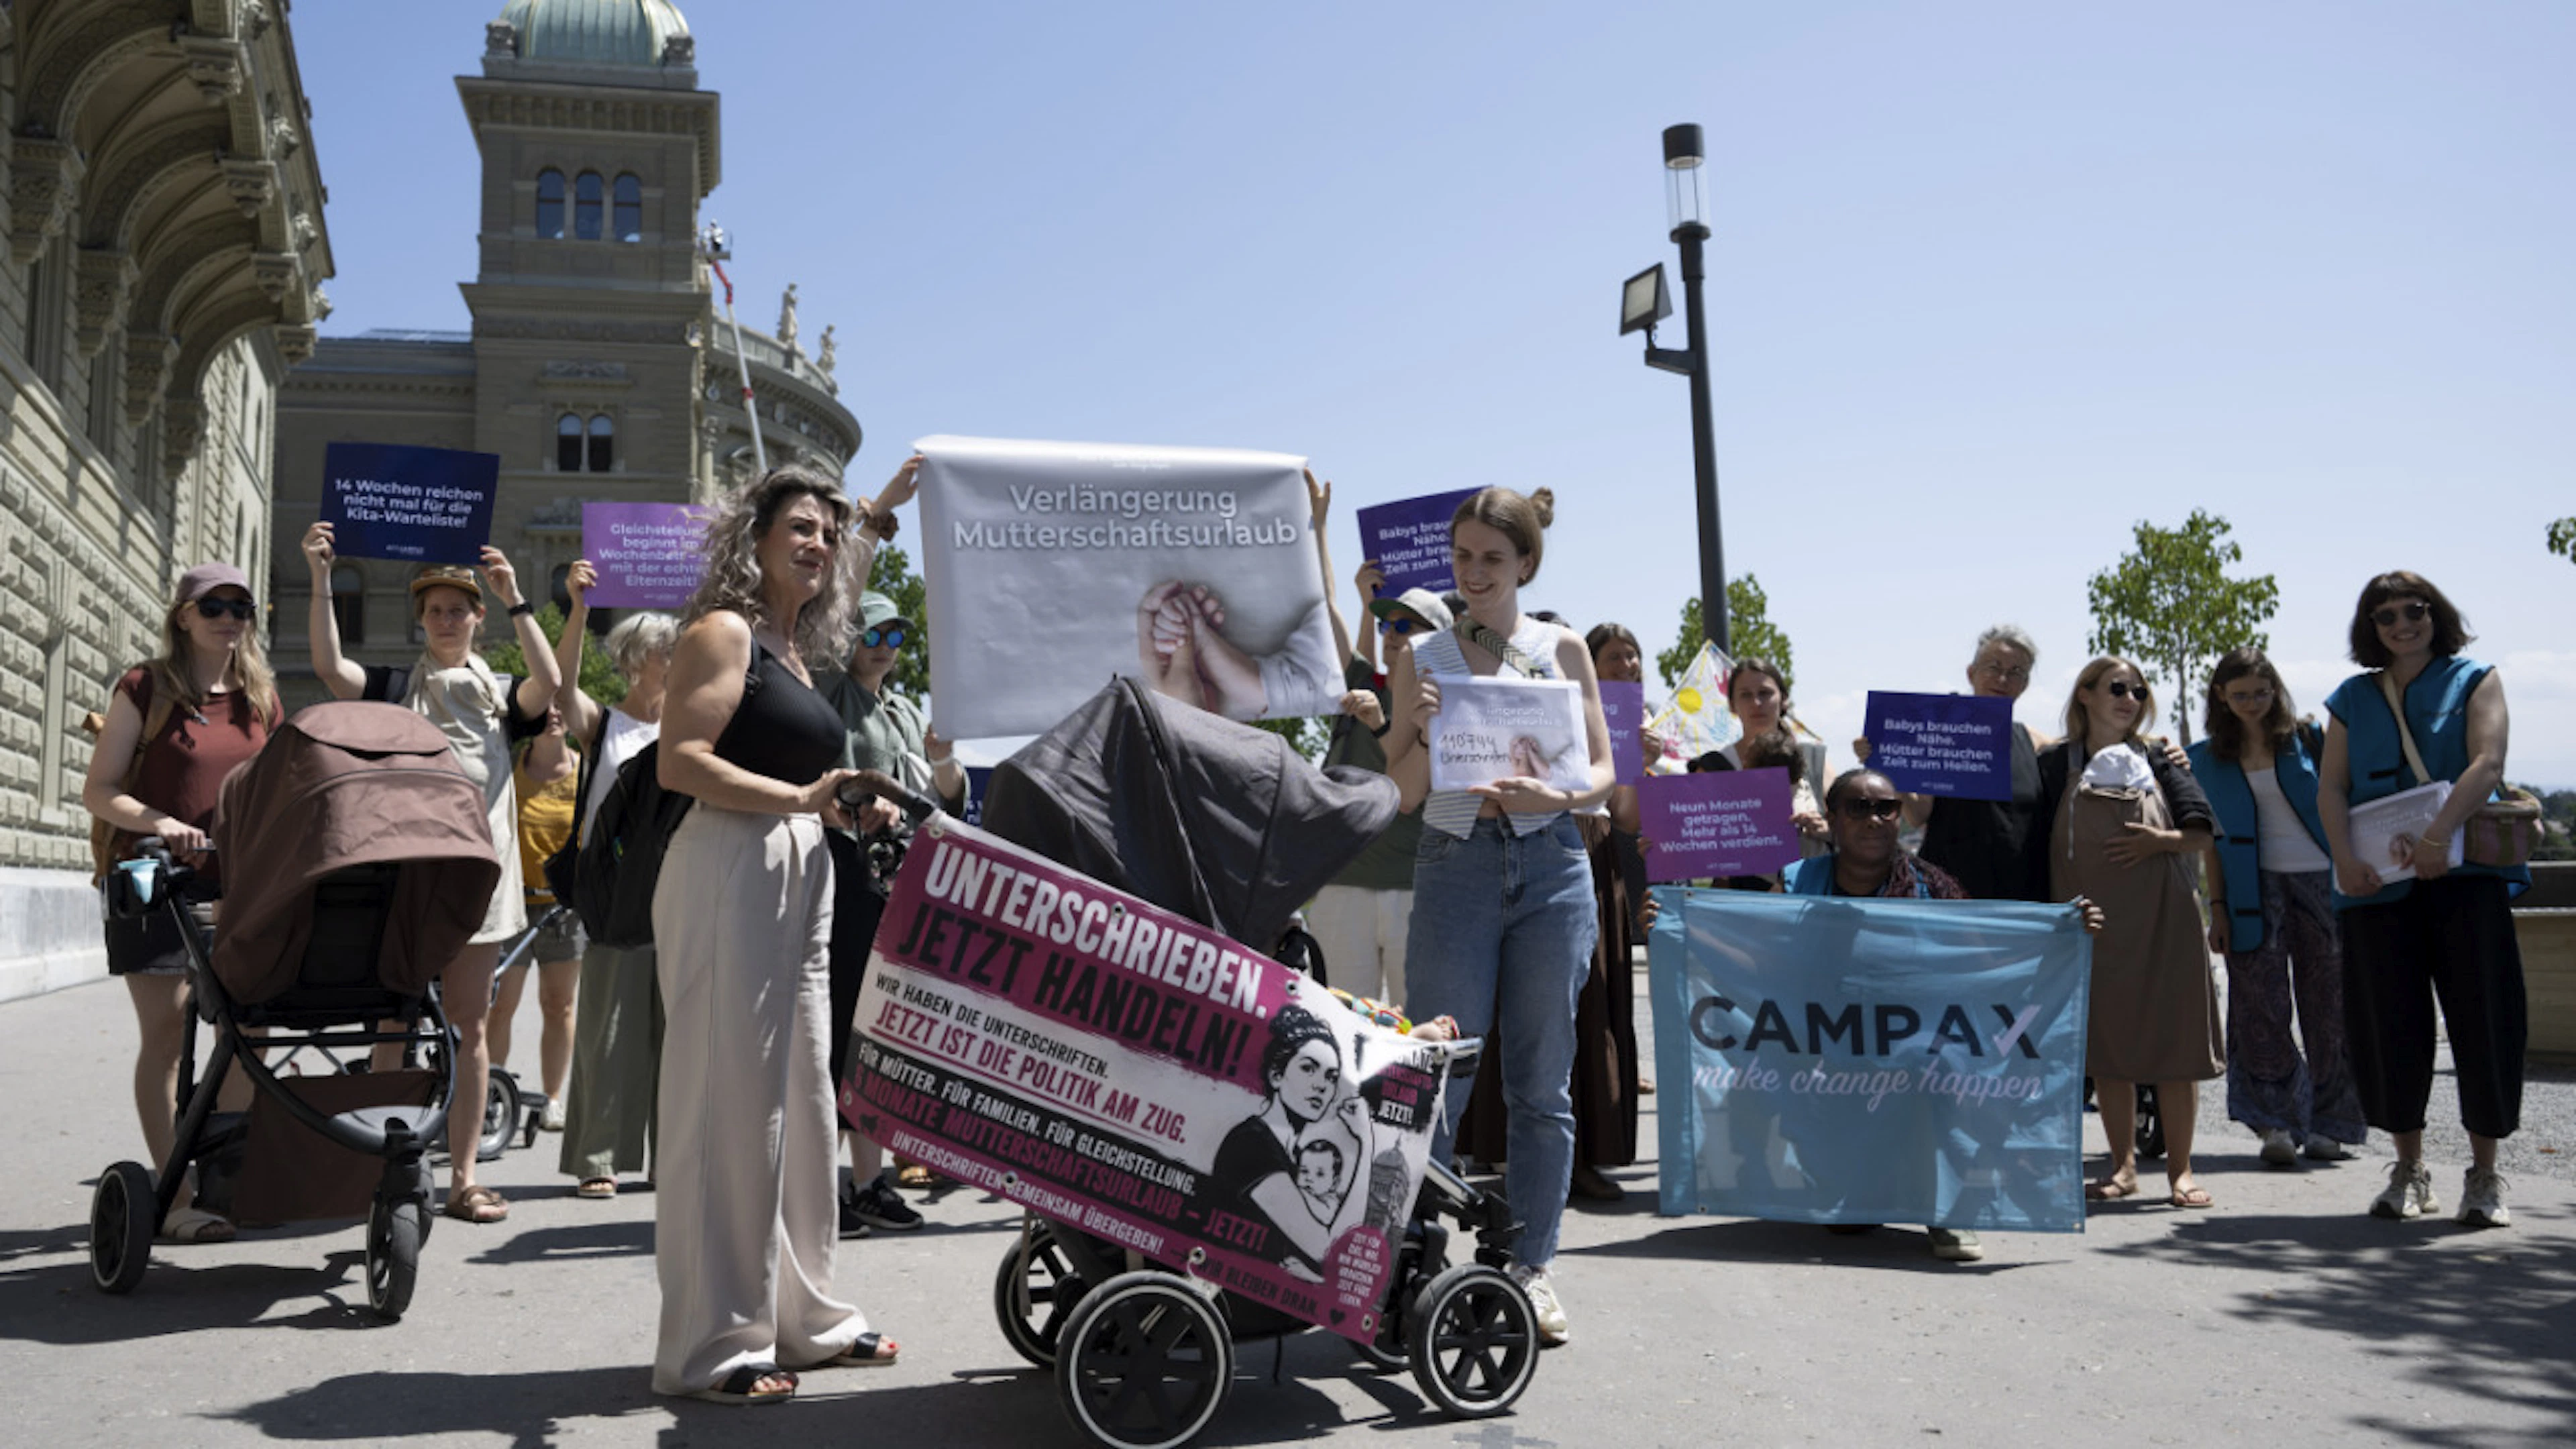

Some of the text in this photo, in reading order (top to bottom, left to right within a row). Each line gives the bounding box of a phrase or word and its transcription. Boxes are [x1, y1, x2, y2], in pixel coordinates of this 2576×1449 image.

[335, 478, 483, 501] 14 Wochen reichen
[343, 493, 472, 514] nicht mal für die
[1010, 484, 1236, 518] Verlängerung
[347, 506, 468, 528] Kita-Warteliste!
[623, 537, 677, 549] beginnt
[953, 519, 1297, 549] Mutterschaftsurlaub
[1379, 526, 1418, 540] Babys
[1414, 533, 1450, 546] Nähe.
[609, 561, 633, 573] mit
[637, 562, 660, 573] der
[1381, 550, 1424, 564] Mütter
[1385, 562, 1411, 575] Zeit
[1412, 558, 1440, 571] zum
[625, 576, 696, 586] Elternzeit!
[1884, 718, 1991, 735] Babys brauchen
[1917, 733, 1956, 746] Nähe.
[1879, 743, 1993, 761] Mütter brauchen
[1882, 756, 1991, 773] Zeit zum Heilen.
[1669, 798, 1762, 814] Neun Monate
[1684, 812, 1751, 826] getragen.
[1681, 823, 1758, 838] Mehr als 14
[1660, 835, 1783, 853] Wochen verdient.
[924, 843, 1266, 1018] UNTERSCHRIEBEN.
[898, 902, 1252, 1077] JETZT HANDELN!
[875, 973, 1109, 1079] WIR HABEN DIE UNTERSCHRIFTEN.
[1688, 996, 2041, 1060] CAMPAX
[876, 1001, 1185, 1143] JETZT IST DIE POLITIK AM ZUG.
[1693, 1057, 2043, 1112] make change happen
[859, 1042, 1196, 1196] FÜR MÜTTER. FÜR FAMILIEN. FÜR GLEICHSTELLUNG.
[1378, 1100, 1414, 1124] JETZT!
[864, 1070, 943, 1128] MONATE
[942, 1107, 1183, 1220] MUTTERSCHAFTSURLAUB
[1203, 1207, 1269, 1252] JETZT!
[892, 1130, 1004, 1189] UNTERSCHRIFTEN
[1084, 1204, 1165, 1254] ÜBERGEBEN!
[1226, 1266, 1279, 1301] BLEIBEN
